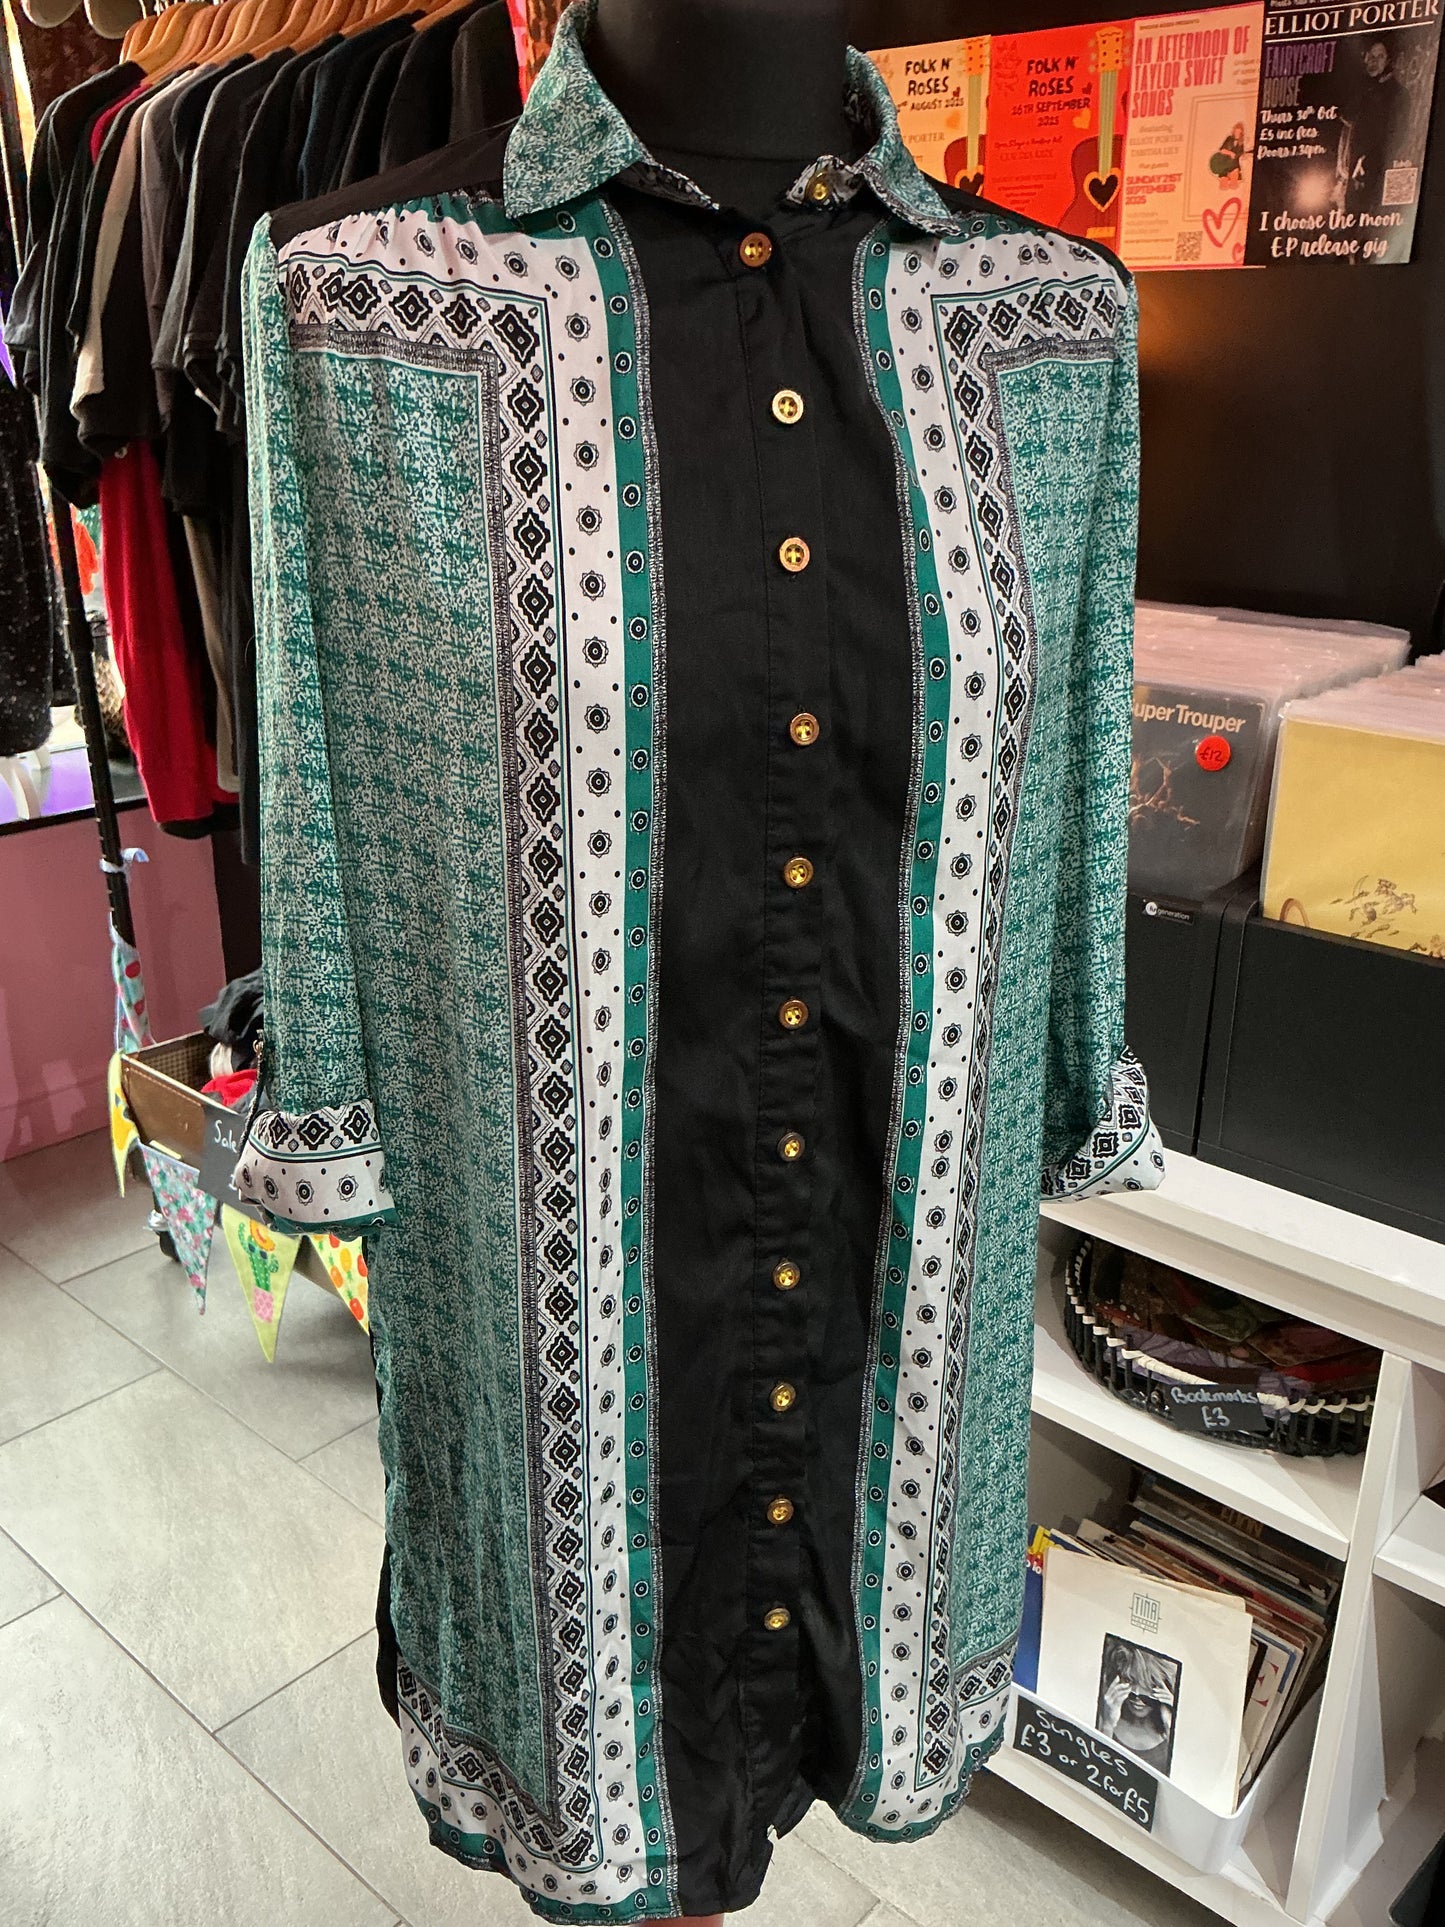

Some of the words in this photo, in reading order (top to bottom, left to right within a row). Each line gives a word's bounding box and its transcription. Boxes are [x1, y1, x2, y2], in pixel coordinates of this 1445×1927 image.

[1264, 10, 1345, 36] ELLIOT
[1349, 0, 1439, 27] PORTER
[1135, 36, 1152, 65] AN
[1156, 28, 1230, 62] AFTERNOON
[1233, 25, 1251, 55] OF
[905, 58, 937, 76] FOLK
[1027, 57, 1061, 75] FOLK
[1265, 41, 1337, 77] FAIRYCROFT
[1134, 61, 1181, 92] TAYLOR
[1184, 56, 1225, 88] SWIFT
[1131, 88, 1175, 119] SONGS
[1262, 75, 1302, 108] HOUSE
[910, 98, 943, 112] AUGUST
[1036, 97, 1091, 113] SEPTEMBER
[1260, 109, 1293, 124] Thurs
[1317, 105, 1338, 120] Oct
[908, 132, 945, 143] PORTER
[1257, 145, 1290, 160] Doors
[1126, 174, 1161, 185] SUNDAY
[1126, 184, 1176, 195] SEPTEMBER
[1259, 211, 1269, 232] I
[1273, 209, 1326, 231] choose
[1328, 208, 1356, 230] the
[1359, 212, 1404, 228] moon
[1299, 233, 1361, 258] release
[1362, 237, 1389, 259] gig
[1132, 703, 1175, 722] uper
[1176, 704, 1246, 734] Trouper
[1200, 746, 1222, 762] £12
[214, 1119, 238, 1154] Sale
[1171, 1386, 1259, 1404] Bookmarks
[1201, 1405, 1231, 1429] £3
[1135, 1596, 1158, 1622] TINA
[1035, 1709, 1129, 1777] Singles
[1020, 1723, 1052, 1756] £3
[1058, 1754, 1079, 1767] or
[1086, 1764, 1102, 1788] 2
[1103, 1775, 1124, 1797] for
[1123, 1787, 1150, 1824] £5
